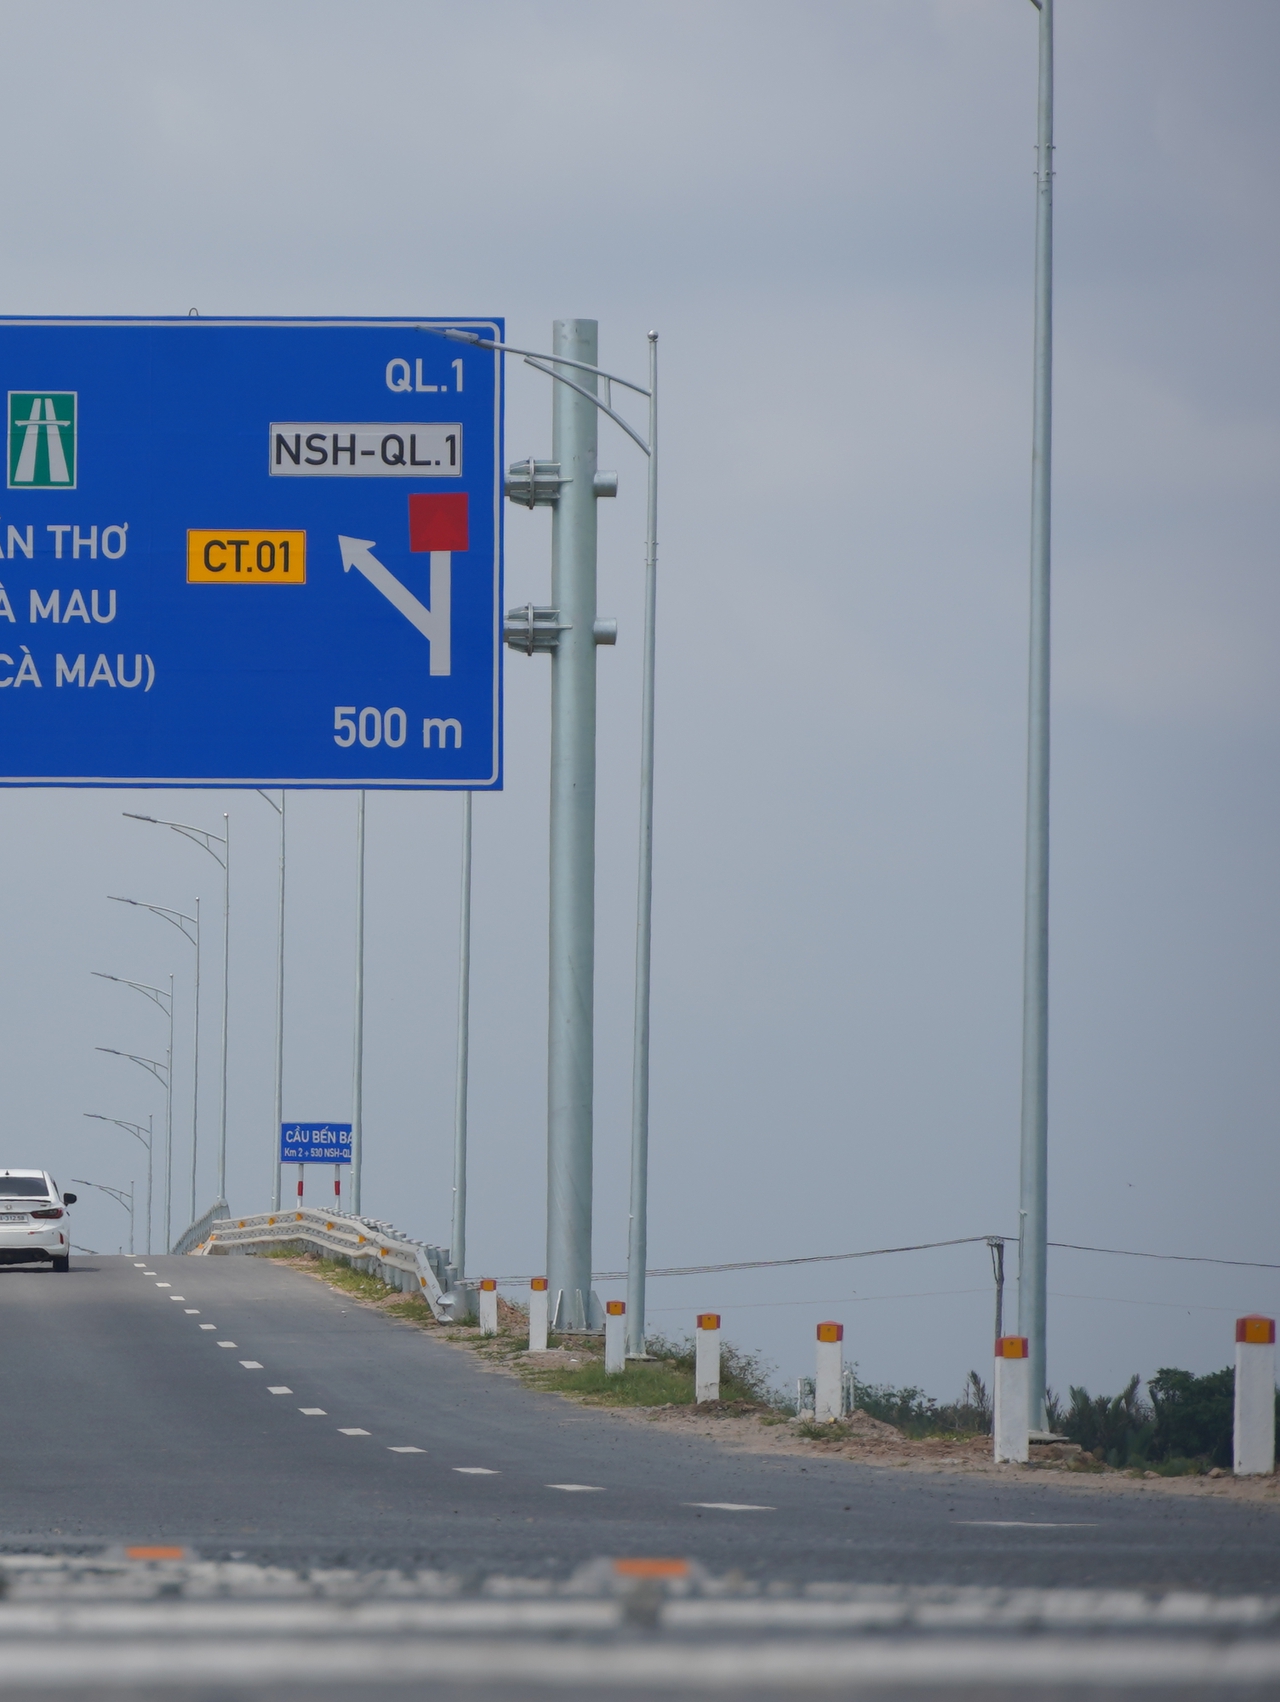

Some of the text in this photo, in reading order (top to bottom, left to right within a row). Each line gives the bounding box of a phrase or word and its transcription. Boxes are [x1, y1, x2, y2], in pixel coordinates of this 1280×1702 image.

[385, 358, 463, 393] QL.1
[275, 433, 456, 467] NSH-QL.1
[46, 522, 129, 560] THƠ
[203, 539, 290, 573] CT.01
[29, 589, 117, 624] MAU
[55, 653, 155, 692] MAU)
[333, 706, 462, 749] 500 m
[285, 1125, 310, 1143] CẦU
[312, 1125, 336, 1144] BẾN
[284, 1147, 297, 1157] Km
[297, 1147, 303, 1158] 2
